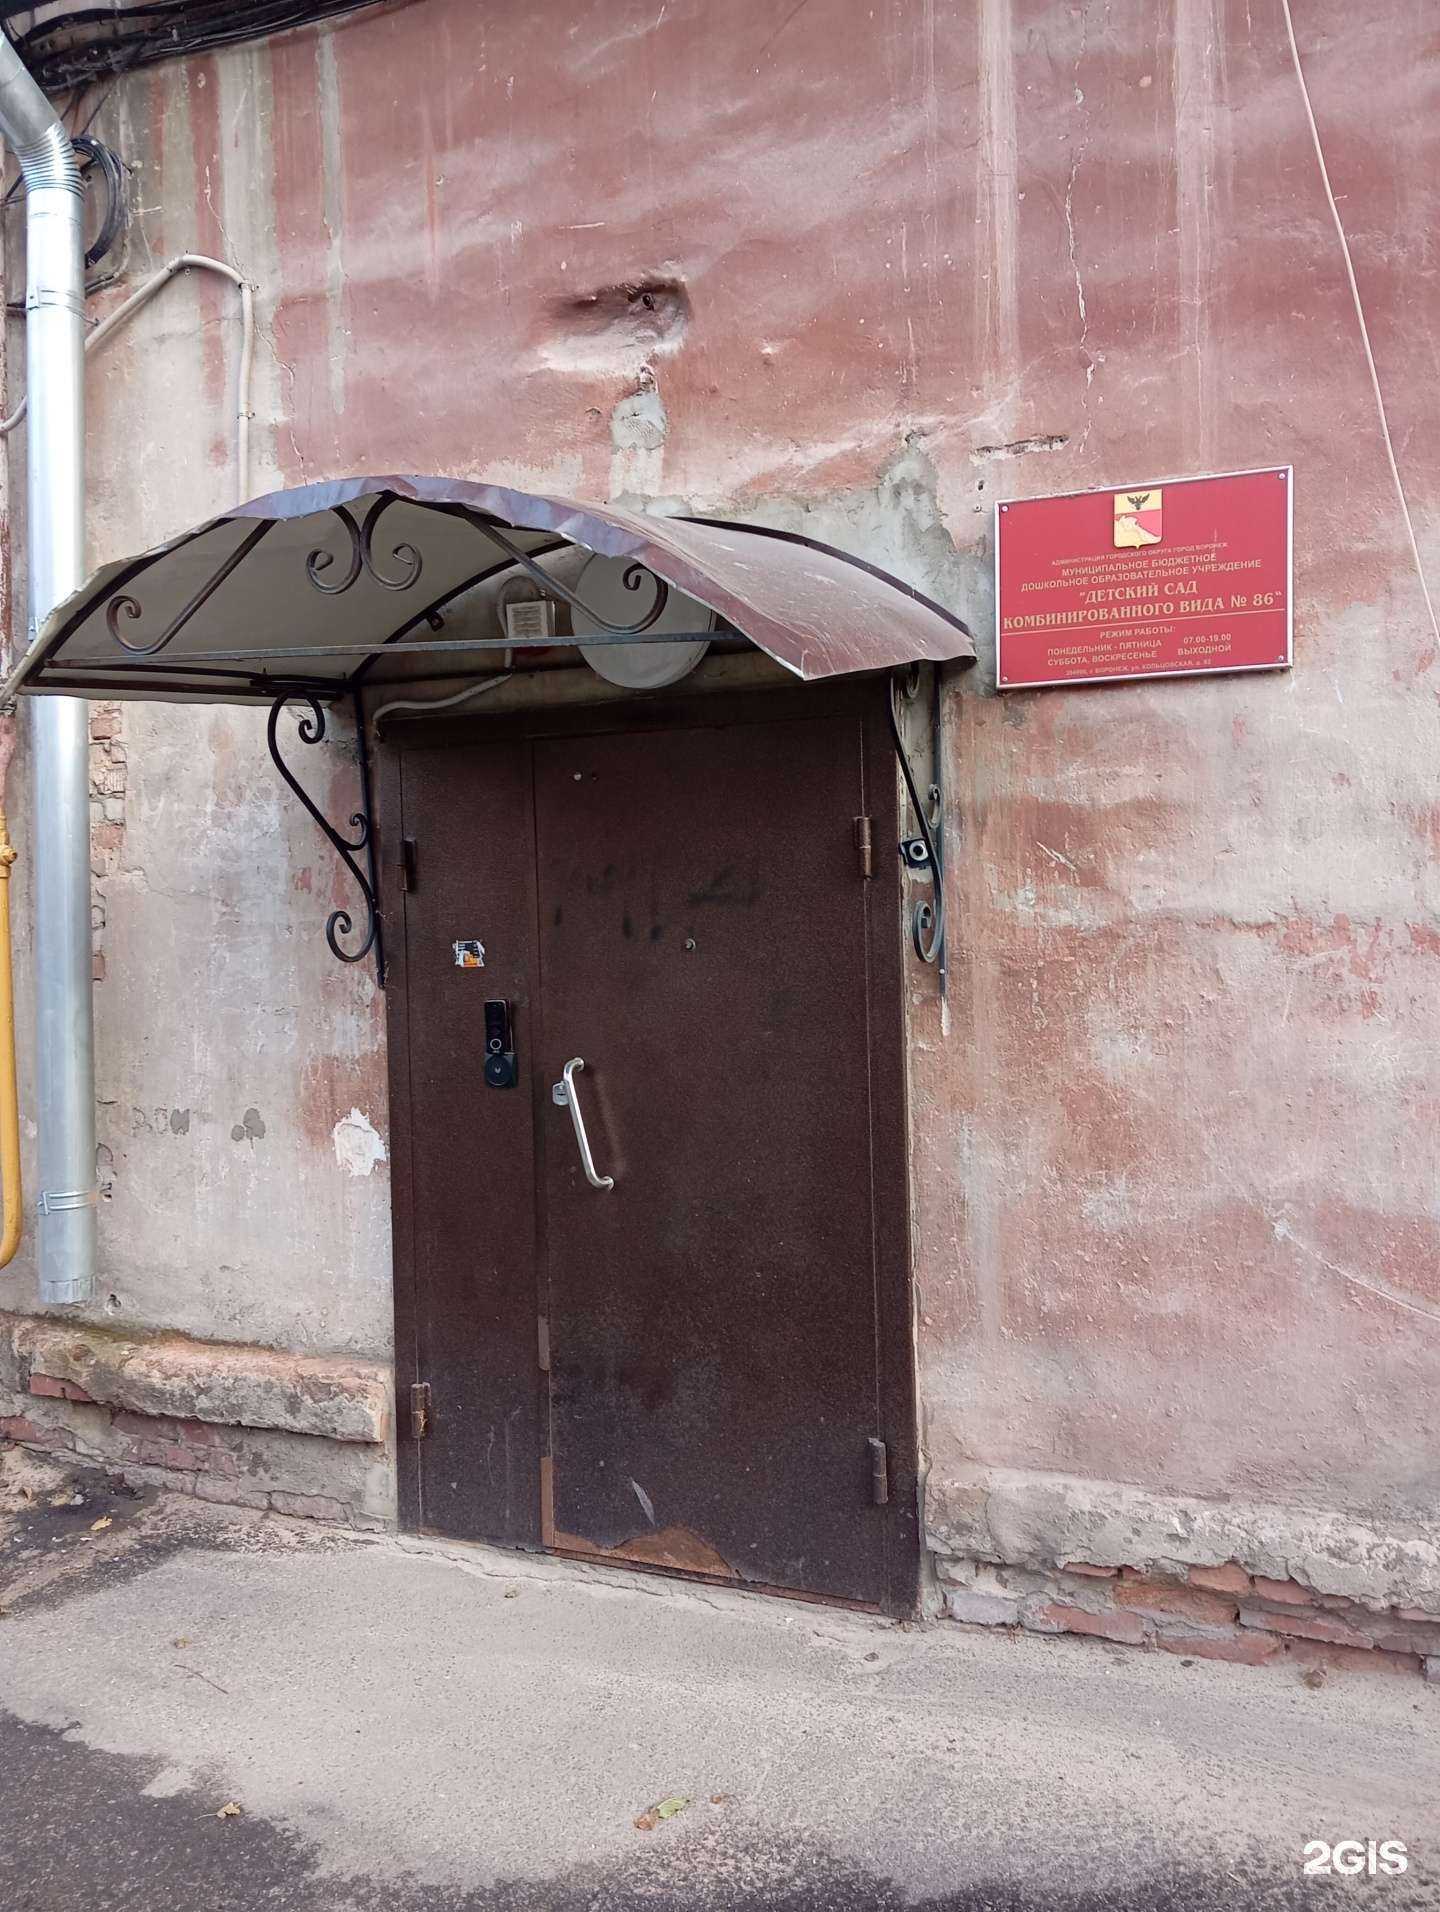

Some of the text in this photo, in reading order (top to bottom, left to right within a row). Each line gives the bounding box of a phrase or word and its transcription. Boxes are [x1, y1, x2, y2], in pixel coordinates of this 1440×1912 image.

[1062, 553, 1217, 577] МУНИЦИПАЛЬНОЕ БЮДЖЕТНОЕ
[1021, 559, 1262, 592] ДОШКОЛЬНОЕ ОБРАЗОВАТЕЛЬНОЕ УЧРЕЖДЕНИЕ
[1164, 580, 1198, 595] САД
[1003, 602, 1174, 629] КОМБИНИРОВАННОГО
[1179, 597, 1225, 614] ВИДА
[1231, 594, 1248, 608] №
[1100, 626, 1176, 639] РЕЖИМ РАБОТЫ:
[1047, 643, 1112, 656] ПОНЕДЕЛЬНИК
[1120, 639, 1162, 650] ПЯТНИЦА
[1092, 650, 1158, 663] ВОСКРЕСЕНЬЕ
[1177, 643, 1232, 656] ВЫХОДНОЙ
